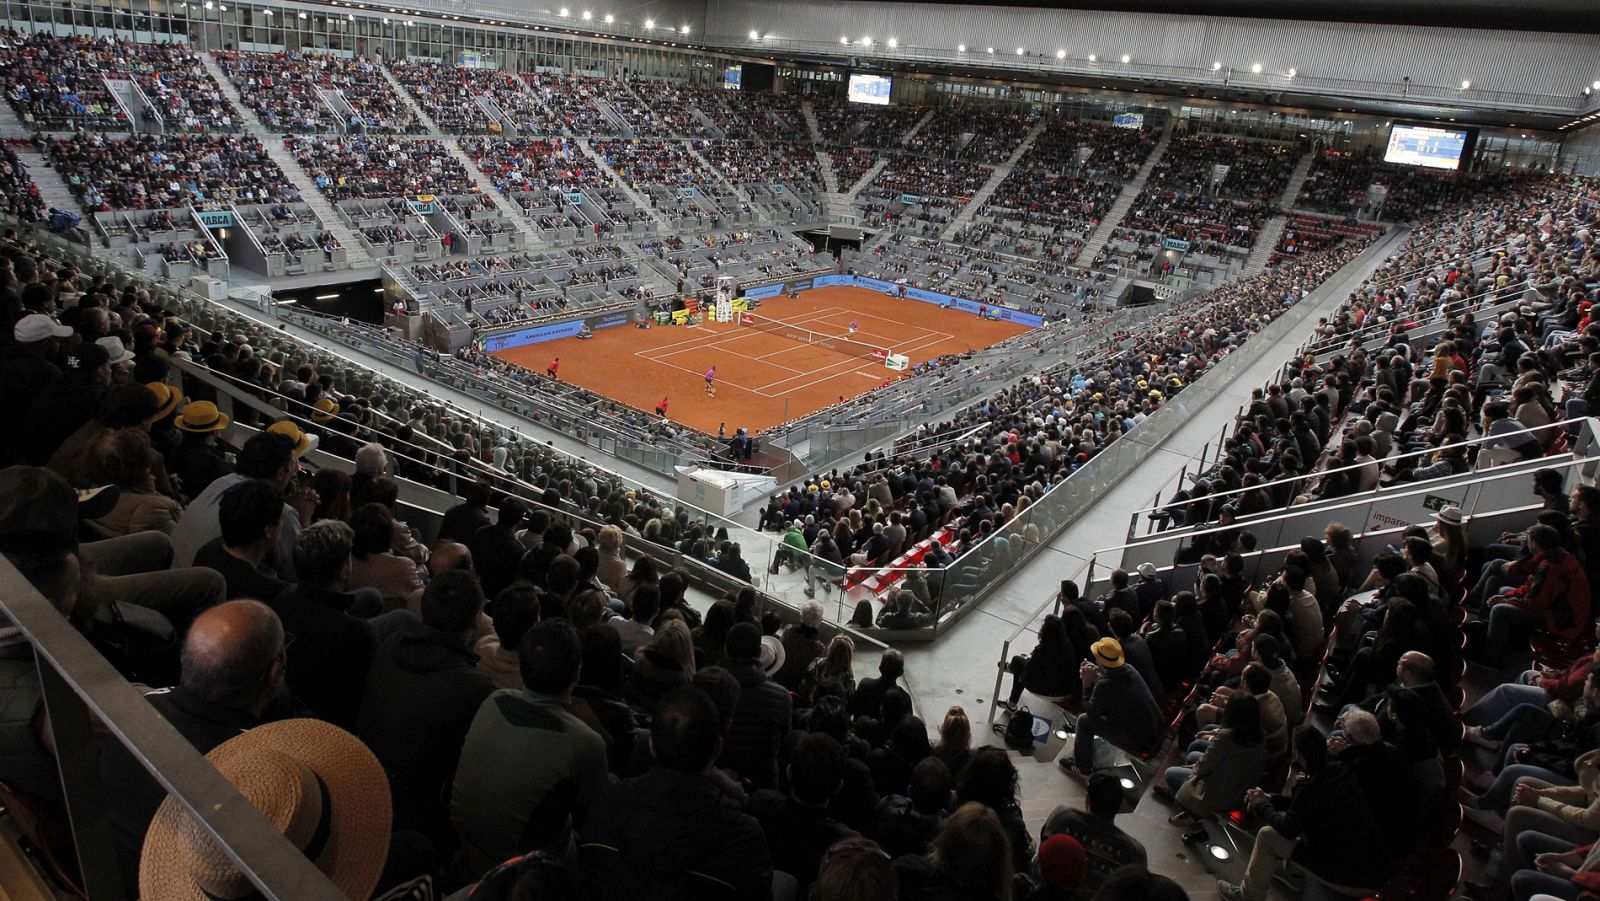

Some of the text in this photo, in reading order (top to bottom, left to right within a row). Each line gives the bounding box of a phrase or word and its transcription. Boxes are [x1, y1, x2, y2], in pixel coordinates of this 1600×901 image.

[409, 204, 431, 212] ARCA
[1167, 240, 1188, 249] MARCA
[525, 331, 552, 339] AMERICAN
[552, 327, 573, 335] EXPRESS
